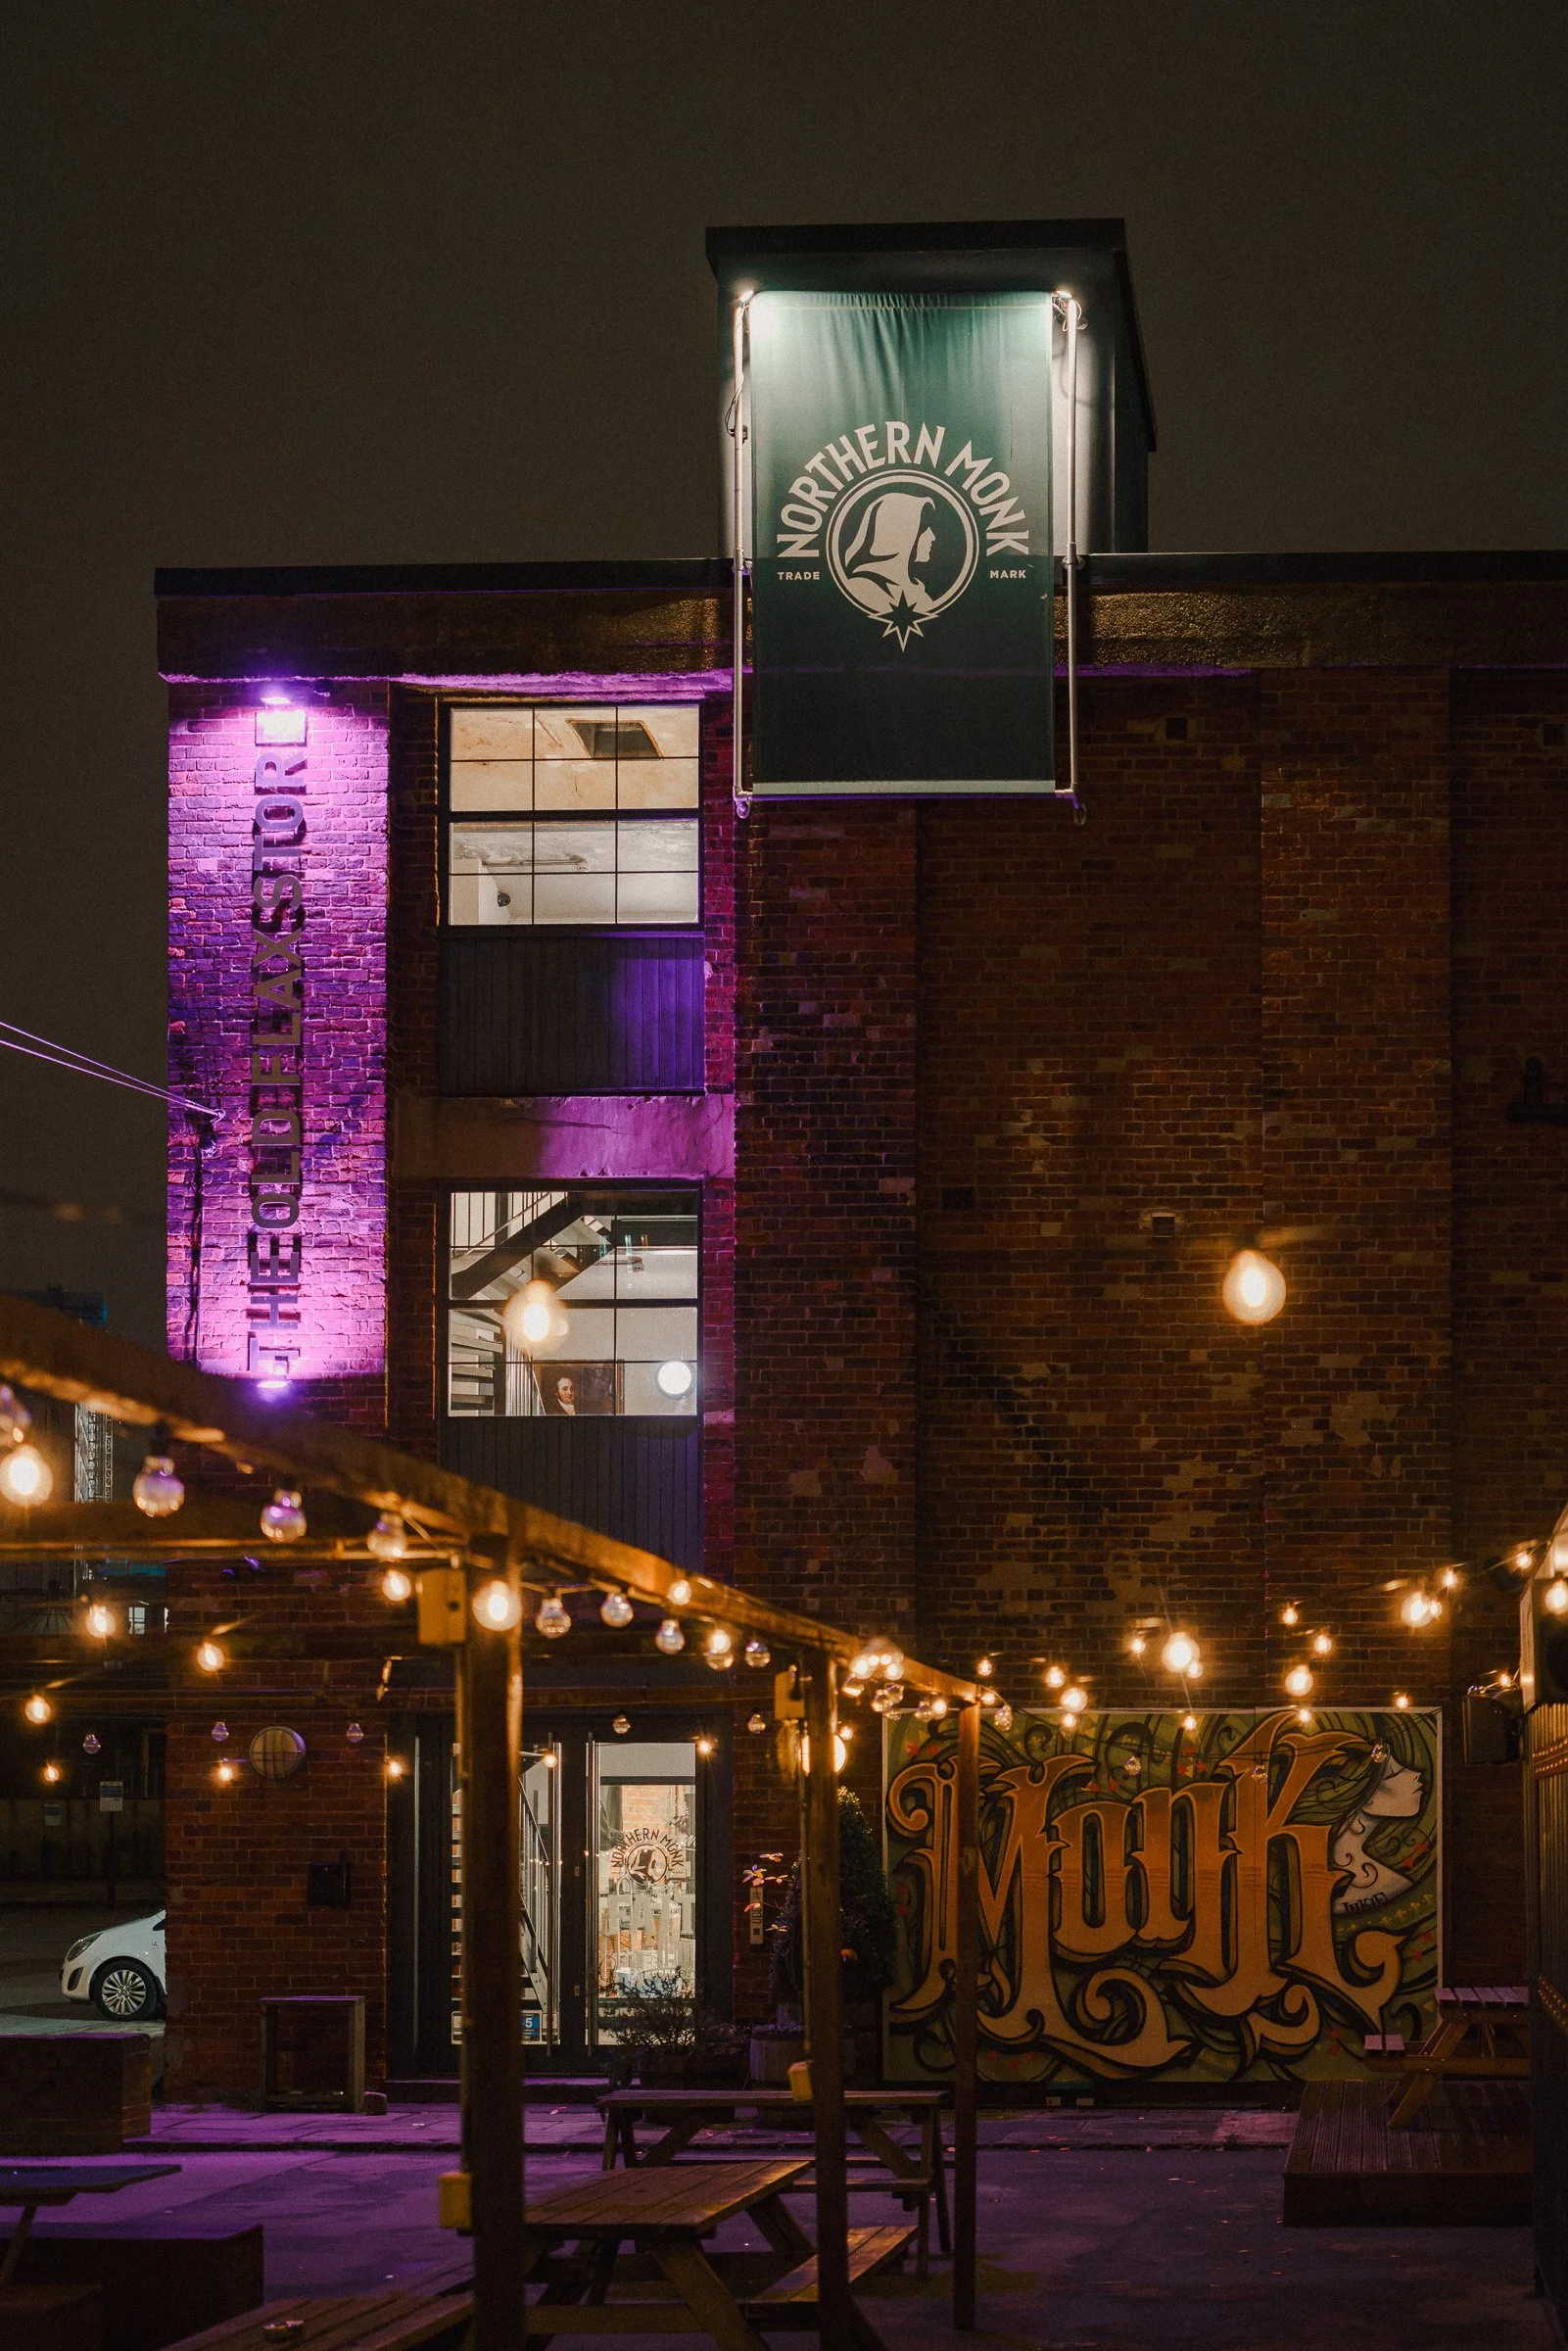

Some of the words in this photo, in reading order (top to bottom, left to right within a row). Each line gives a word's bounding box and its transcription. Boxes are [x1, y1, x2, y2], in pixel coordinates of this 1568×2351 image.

[777, 421, 945, 558] NORTHERN
[944, 440, 1029, 557] MONK
[777, 571, 820, 581] TRADE
[989, 569, 1026, 579] MARK
[252, 710, 306, 909] STOR
[252, 930, 302, 1085] FLAX
[251, 1109, 300, 1229] OLD
[250, 1251, 299, 1372] THE
[660, 1834, 685, 1867] MONK
[525, 2017, 533, 2028] 5
